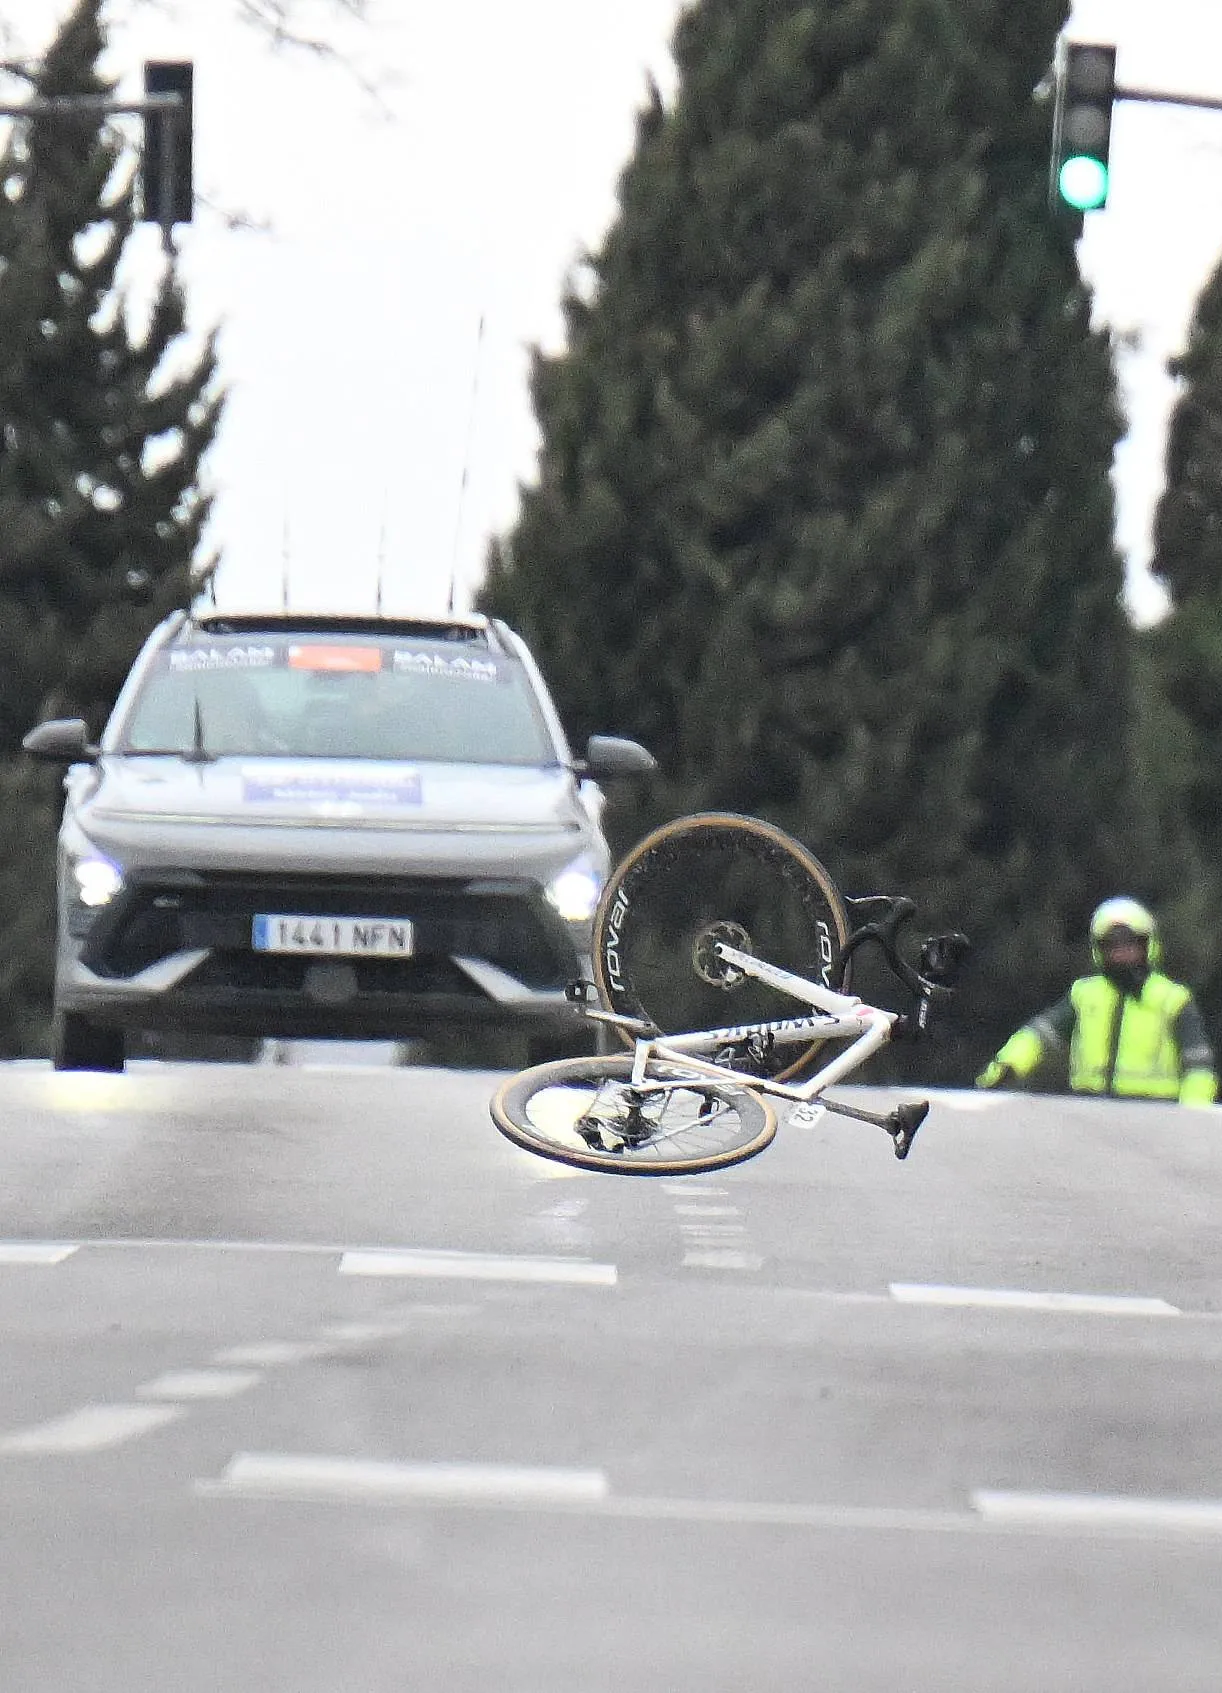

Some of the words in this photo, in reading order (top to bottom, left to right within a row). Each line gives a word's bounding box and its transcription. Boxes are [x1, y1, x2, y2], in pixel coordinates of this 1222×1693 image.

[279, 919, 340, 946] 1441
[606, 886, 629, 992] roval
[816, 920, 832, 989] rov
